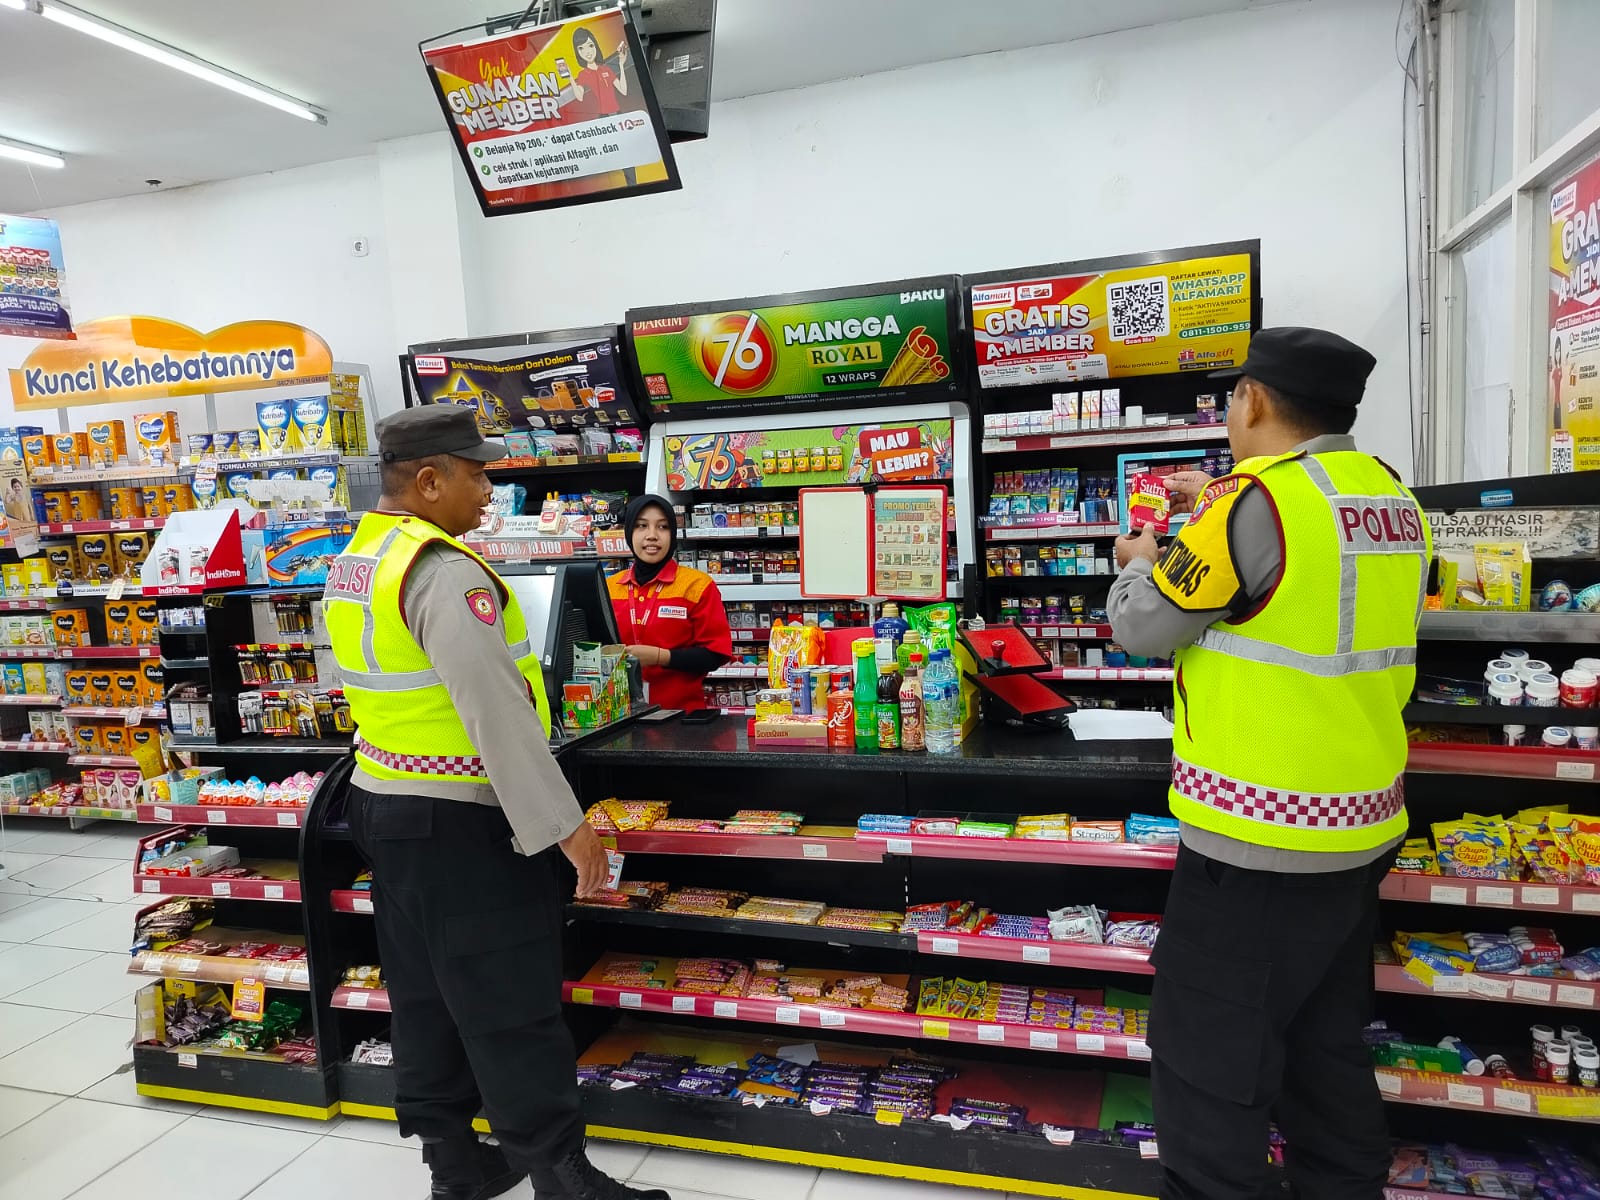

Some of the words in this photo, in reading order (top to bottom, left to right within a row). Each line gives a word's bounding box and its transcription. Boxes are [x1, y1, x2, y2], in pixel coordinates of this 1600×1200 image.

[447, 72, 560, 114] GUNAKAN
[461, 97, 561, 135] MEMBER
[485, 144, 515, 157] Belanja
[515, 141, 526, 151] Rp
[551, 133, 575, 145] dapat
[575, 123, 617, 139] Cashback
[493, 161, 507, 172] cek
[508, 158, 528, 171] struk
[534, 153, 566, 168] aplikasi
[567, 147, 598, 162] Alfagift
[603, 142, 619, 155] dan
[497, 172, 534, 184] dapatkan
[535, 164, 579, 178] kejutannya
[1562, 200, 1600, 263] GRA
[1171, 272, 1195, 280] DAFTAR
[1172, 273, 1246, 291] WHATSAPP
[900, 288, 945, 305] BARU
[973, 291, 1011, 301] Alfamart
[1172, 284, 1243, 302] ALFAMART
[985, 304, 1089, 336] GRATIS
[783, 315, 900, 345] MANGGA
[1027, 328, 1047, 336] JADI
[711, 312, 764, 388] 76
[812, 344, 878, 365] ROYAL
[1197, 347, 1234, 359] Alfagift
[526, 358, 544, 369] Dari
[544, 354, 573, 366] Dalam
[25, 365, 96, 398] Kunci
[102, 347, 295, 390] Kehebatannya
[825, 375, 836, 385] 12
[838, 371, 877, 382] WRAPS
[870, 432, 909, 451] MAU
[692, 434, 736, 482] 76
[876, 451, 929, 475] LEBIH?
[1140, 478, 1166, 497] Sutra
[883, 502, 910, 510] PROMO
[1338, 506, 1424, 542] POLISI
[1475, 515, 1491, 525] DI
[1495, 515, 1543, 525] KASIR
[207, 570, 241, 579] IndiHome
[327, 562, 374, 595] POLISI
[660, 607, 686, 616] Alfamart
[1076, 830, 1116, 840] Strepsils
[1459, 846, 1489, 854] Chupa
[1502, 1081, 1568, 1096] Permen
